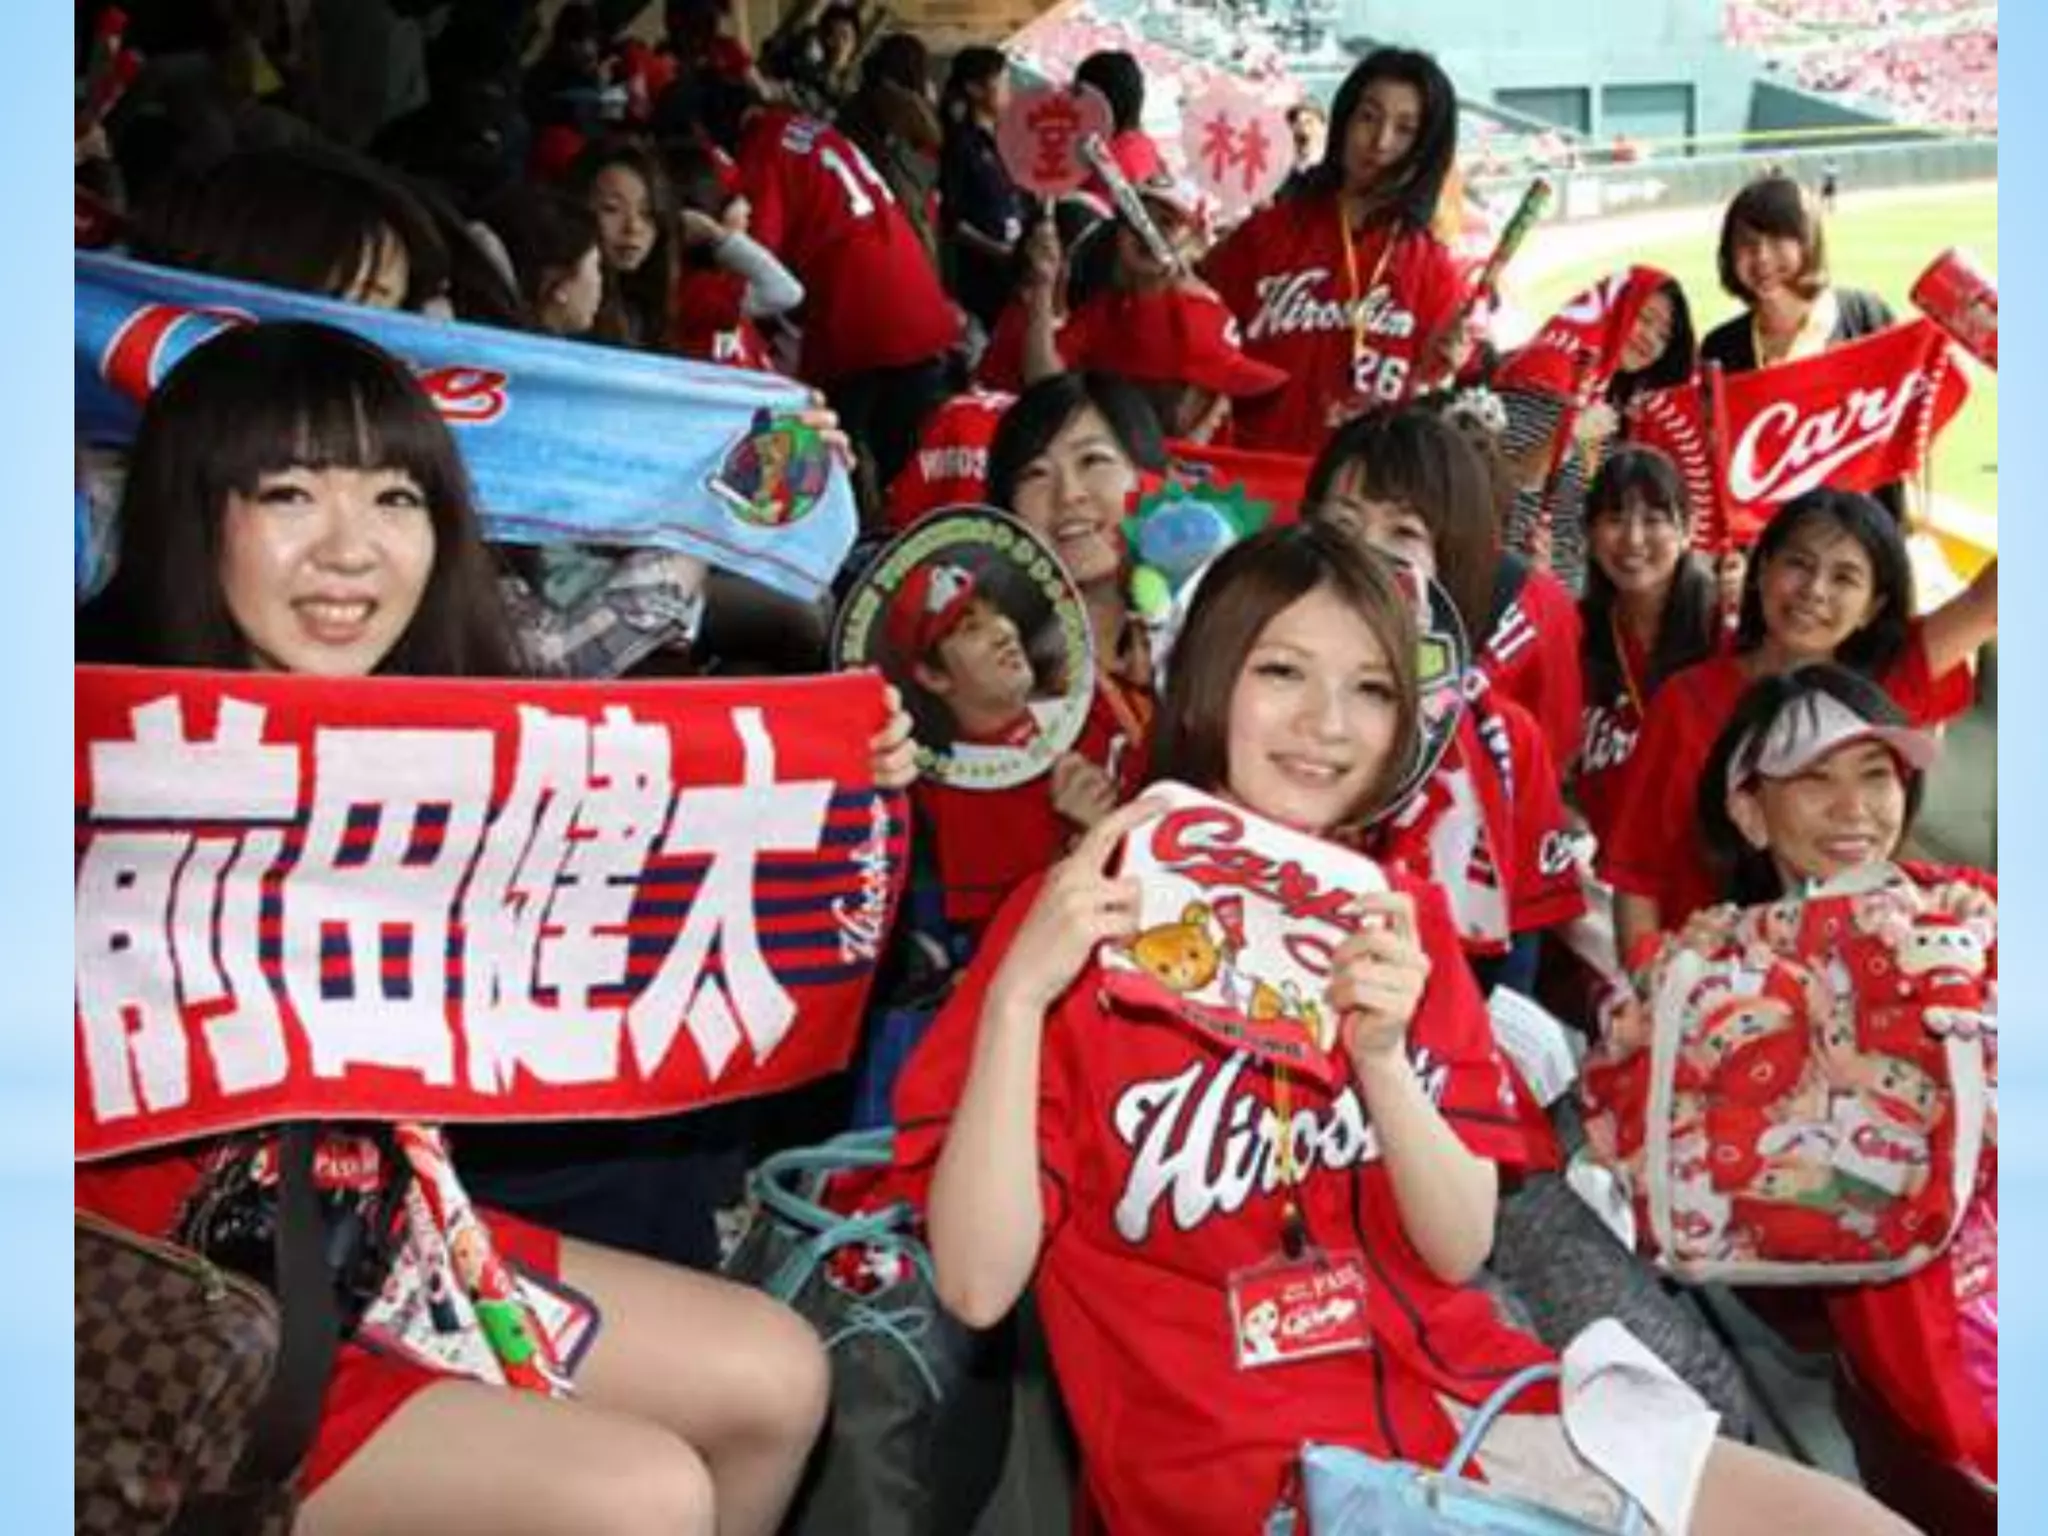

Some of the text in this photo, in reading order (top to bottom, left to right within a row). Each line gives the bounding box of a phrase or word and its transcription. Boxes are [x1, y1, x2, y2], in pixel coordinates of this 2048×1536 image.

[1199, 110, 1271, 194] 林
[75, 693, 835, 1126] 前田健太
